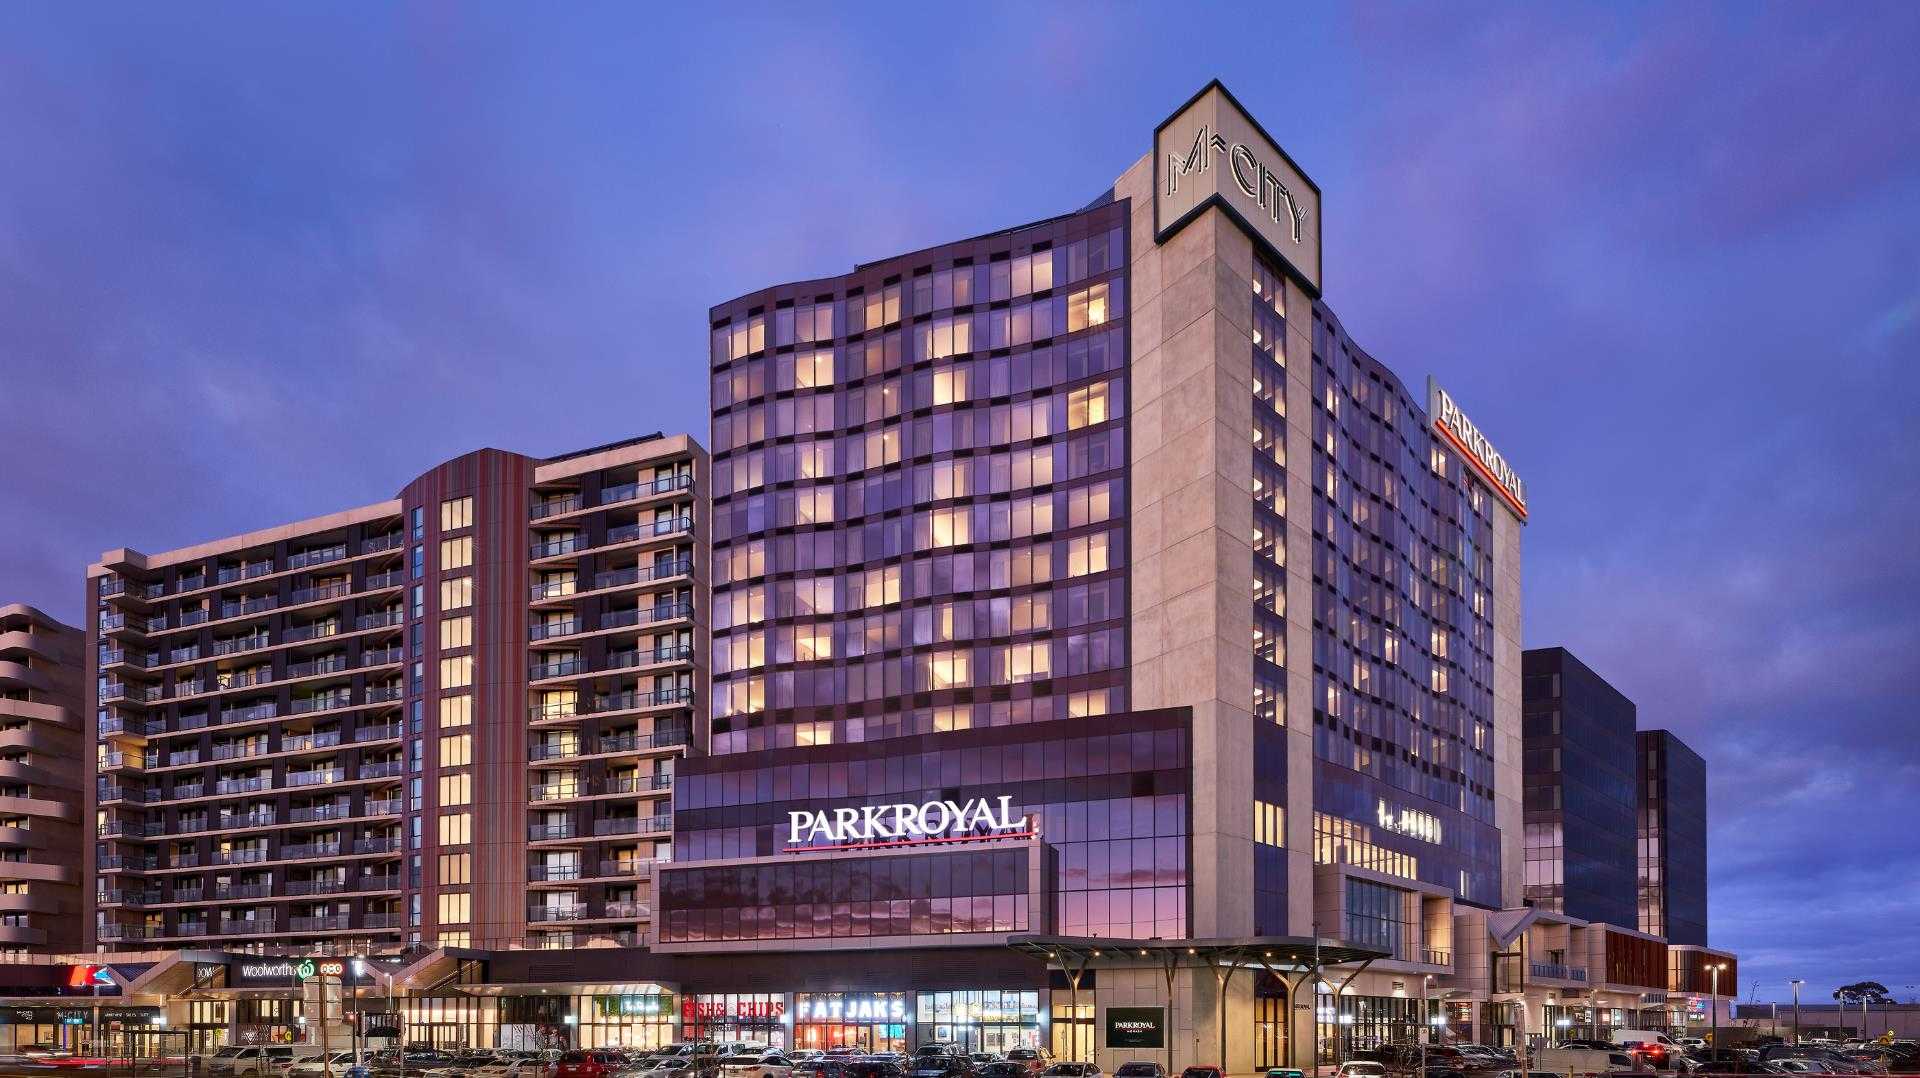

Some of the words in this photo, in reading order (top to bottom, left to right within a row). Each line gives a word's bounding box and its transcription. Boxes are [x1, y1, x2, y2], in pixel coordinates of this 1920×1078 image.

[1439, 389, 1526, 506] PARKROYAL
[787, 795, 1027, 843] PARKROYAL
[737, 1001, 784, 1017] CHIPS
[1114, 1021, 1156, 1029] PARKROYAL
